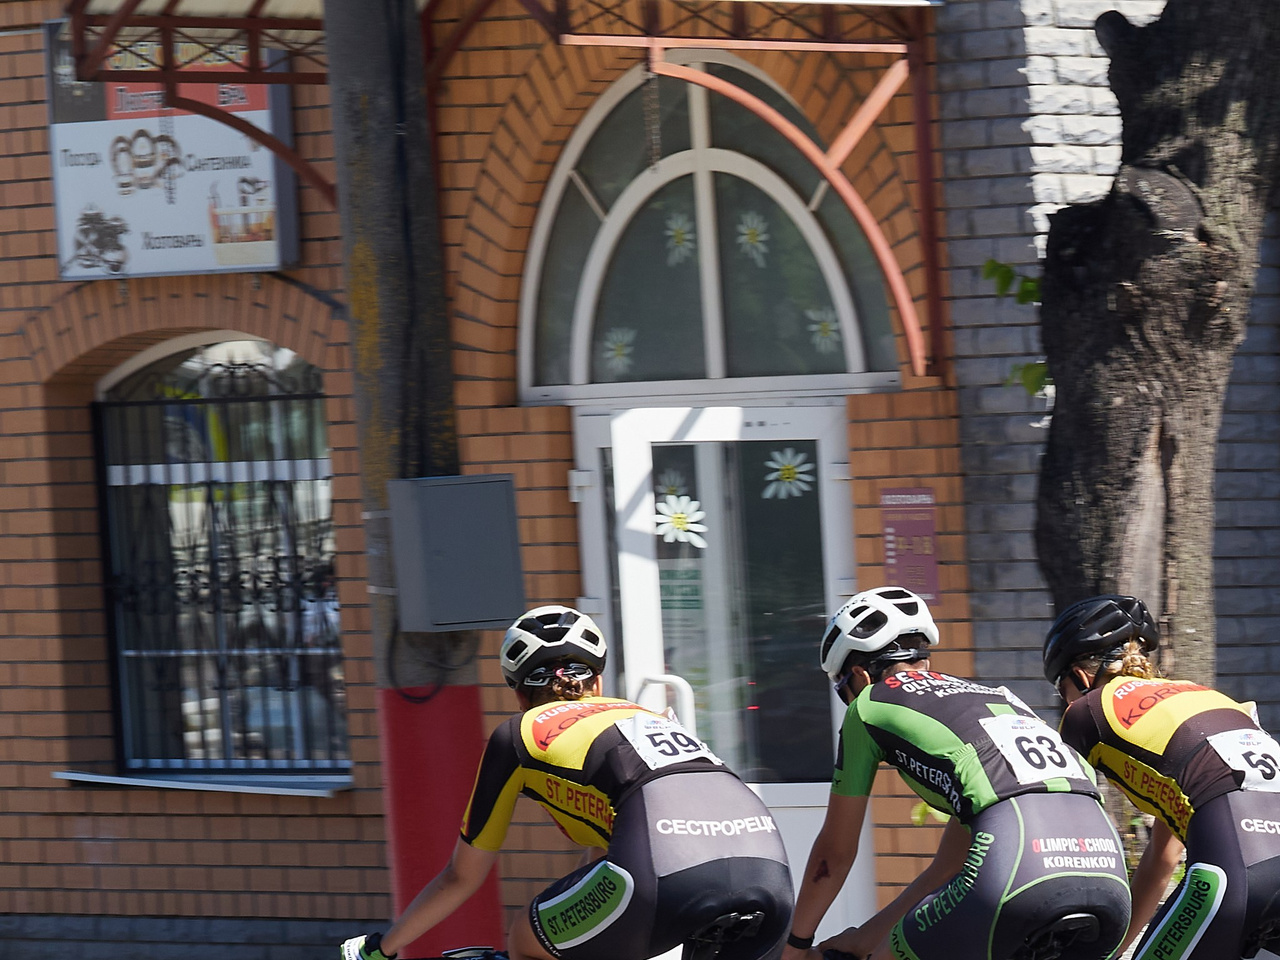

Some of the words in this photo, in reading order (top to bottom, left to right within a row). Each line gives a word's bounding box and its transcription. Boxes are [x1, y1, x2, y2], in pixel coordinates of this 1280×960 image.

[645, 732, 702, 757] 59
[1014, 735, 1068, 770] 63
[656, 816, 776, 836] СЕСТРОРЕЦК
[1043, 856, 1116, 868] KORENKOV
